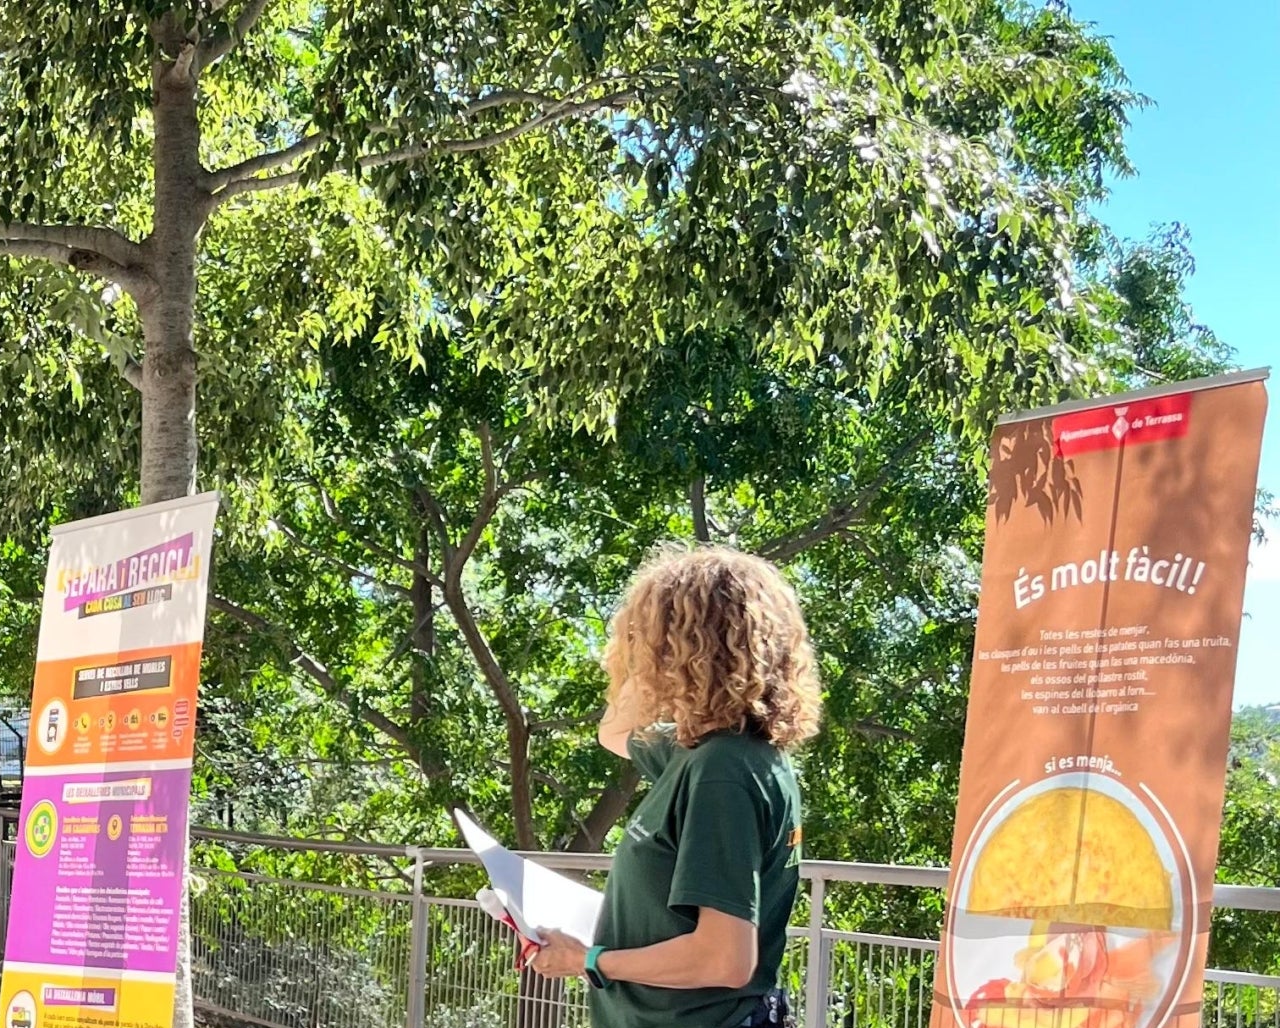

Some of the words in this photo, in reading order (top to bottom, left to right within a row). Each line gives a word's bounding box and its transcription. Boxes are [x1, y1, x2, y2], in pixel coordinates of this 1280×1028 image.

[1132, 418, 1144, 429] de
[1144, 412, 1183, 426] Terrassa
[63, 561, 118, 597] SEPARA
[1013, 567, 1045, 610] És
[1051, 550, 1120, 591] molt
[1124, 546, 1206, 595] fàcil!
[1040, 630, 1063, 640] Totes
[1065, 629, 1080, 640] les
[1081, 628, 1107, 638] restes
[1108, 626, 1118, 636] de
[1044, 645, 1058, 655] les
[1060, 644, 1082, 656] pells
[1083, 643, 1094, 653] de
[1095, 642, 1108, 653] les
[1109, 641, 1137, 654] patates
[1138, 640, 1161, 652] quan
[1164, 638, 1179, 648] fas
[1182, 638, 1200, 648] una
[1011, 661, 1030, 674] pells
[1031, 661, 1041, 670] de
[1043, 660, 1056, 670] les
[1059, 659, 1087, 670] fruites
[1088, 659, 1109, 670] quan
[1124, 657, 1138, 666] una
[1030, 675, 1043, 685] els
[1045, 675, 1072, 684] ossos
[1073, 673, 1086, 683] del
[1087, 672, 1122, 686] pollastre
[1021, 690, 1033, 700] les
[1035, 689, 1070, 701] espines
[1071, 689, 1083, 698] del
[1118, 686, 1126, 696] al
[1032, 706, 1049, 714] van
[1051, 704, 1060, 714] al
[1062, 703, 1086, 714] cubell
[1088, 703, 1099, 713] de
[1044, 756, 1056, 773] si
[1058, 756, 1074, 769] es
